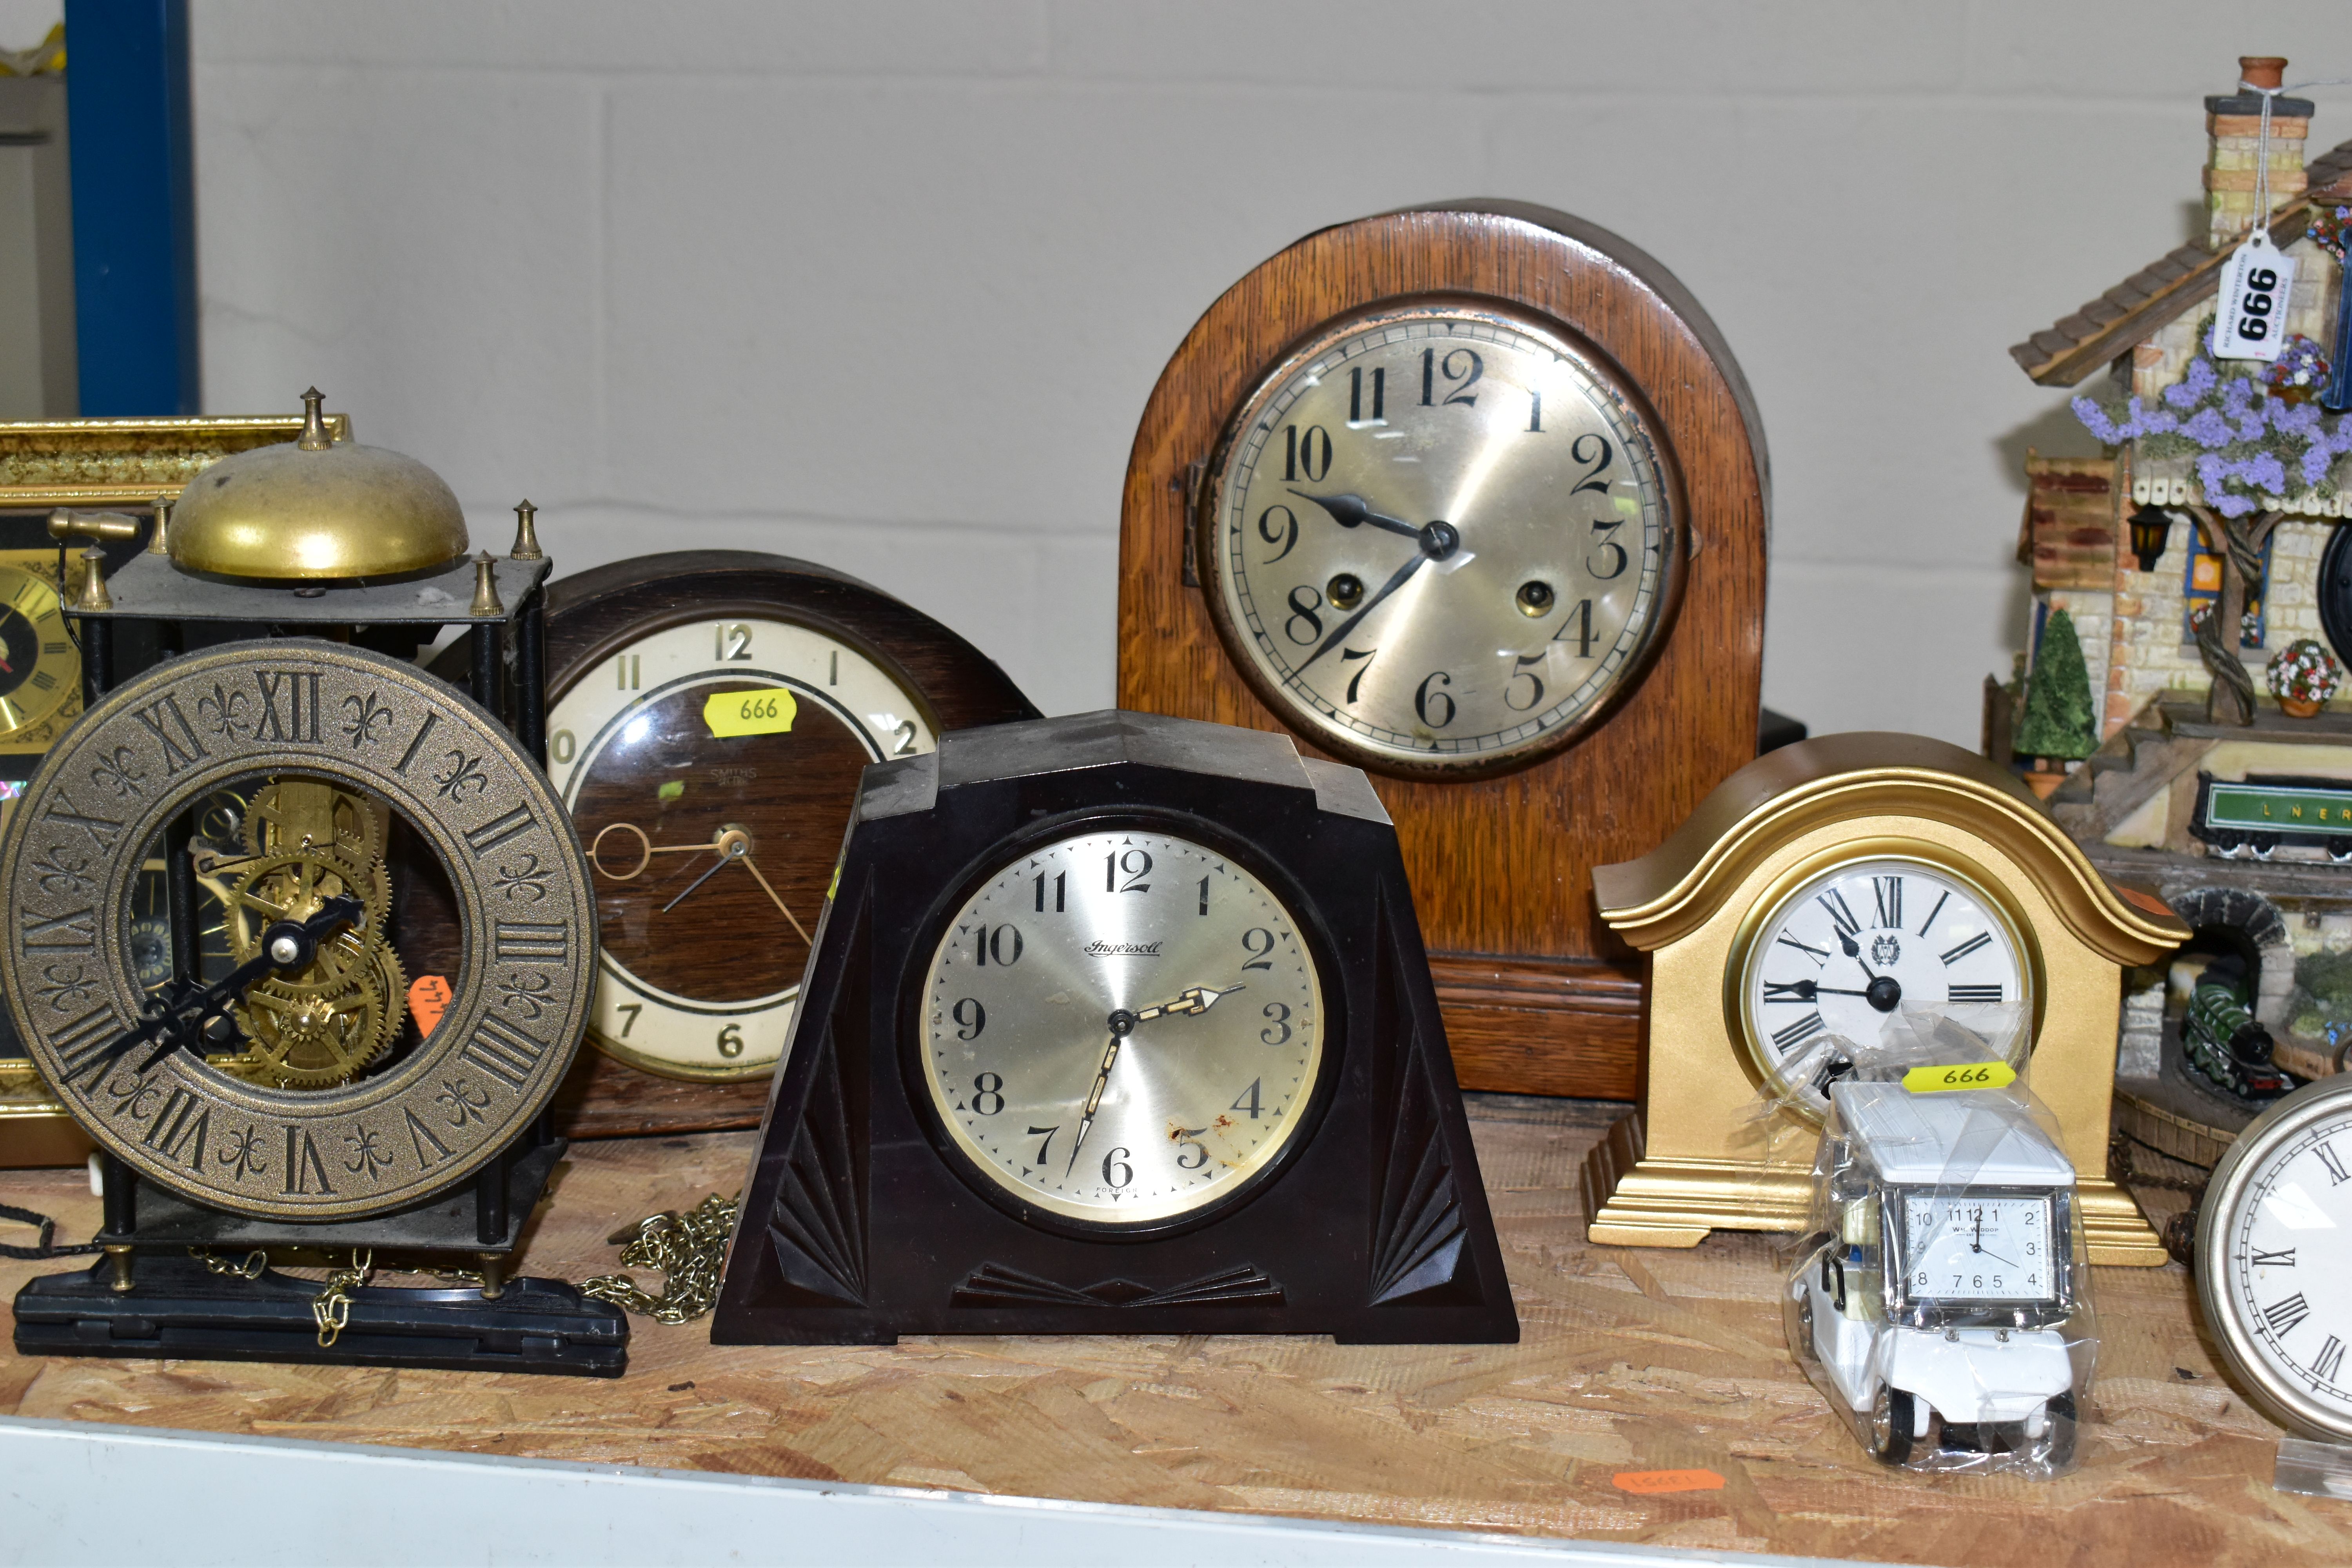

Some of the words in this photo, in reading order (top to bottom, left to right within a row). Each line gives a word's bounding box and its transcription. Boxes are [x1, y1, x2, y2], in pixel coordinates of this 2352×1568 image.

[2223, 309, 2235, 348] RICHARD
[2233, 254, 2247, 305] WINTERTON
[2238, 267, 2277, 341] 666
[2272, 278, 2288, 339] AUCTIONEERS
[1347, 366, 1385, 422] 11
[1417, 348, 1484, 407] 12
[1525, 379, 1546, 433] 1
[1280, 425, 1332, 482] 10
[1570, 434, 1612, 496] 2
[1258, 505, 1299, 564] 9
[1586, 521, 1628, 580] 3
[1285, 585, 1323, 646] 8
[1552, 599, 1600, 658] 4
[715, 624, 752, 661] 12
[1341, 648, 1377, 704] 7
[1504, 651, 1548, 711] 5
[254, 670, 324, 745] XII
[740, 699, 778, 719] 666
[1415, 672, 1455, 728] 6
[132, 693, 211, 777] XI
[391, 710, 445, 777] I
[895, 720, 918, 755] 2
[710, 768, 757, 779] SMITHS
[43, 790, 123, 857] X
[463, 800, 543, 860] II
[1032, 869, 1066, 913] 11
[1104, 849, 1153, 893] 12
[1196, 874, 1209, 916] 1
[1815, 886, 1864, 936] XI
[1870, 876, 1904, 929] XII
[1916, 889, 1952, 939] I
[22, 906, 96, 956] IX
[495, 919, 568, 966] III
[974, 923, 1023, 966] 10
[1084, 940, 1163, 957] Ingersoll
[1241, 927, 1275, 971] 2
[1777, 927, 1831, 969] X
[1939, 930, 1993, 969] II
[1947, 983, 2002, 1002] III
[616, 1004, 643, 1039] 7
[717, 1023, 744, 1058] 6
[953, 998, 986, 1040] 9
[1261, 1002, 1291, 1045] 3
[463, 1007, 550, 1094] IIII
[971, 1072, 1005, 1115] 8
[1229, 1076, 1265, 1119] 4
[1944, 1068, 1989, 1084] 666
[140, 1084, 211, 1175] VII
[404, 1106, 458, 1172] V
[1027, 1125, 1060, 1165] 7
[1176, 1128, 1208, 1169] 5
[279, 1125, 338, 1195] VI
[1102, 1147, 1133, 1188] 6
[2311, 1141, 2351, 1187] XI
[1916, 1212, 1932, 1226] 10
[1947, 1209, 1961, 1221] 11
[1966, 1208, 1983, 1221] 12
[1993, 1209, 1998, 1221] 1
[2025, 1212, 2034, 1225] 2
[1917, 1241, 1926, 1254] 9
[2026, 1242, 2036, 1255] 3
[2251, 1245, 2296, 1267] IX
[1918, 1272, 1927, 1285] 8
[1953, 1275, 1962, 1288] 7
[1973, 1275, 1982, 1288] 6
[1993, 1275, 2002, 1288] 5
[2027, 1273, 2036, 1286] 4
[2262, 1291, 2310, 1340] VIII
[2308, 1334, 2347, 1383] VII
